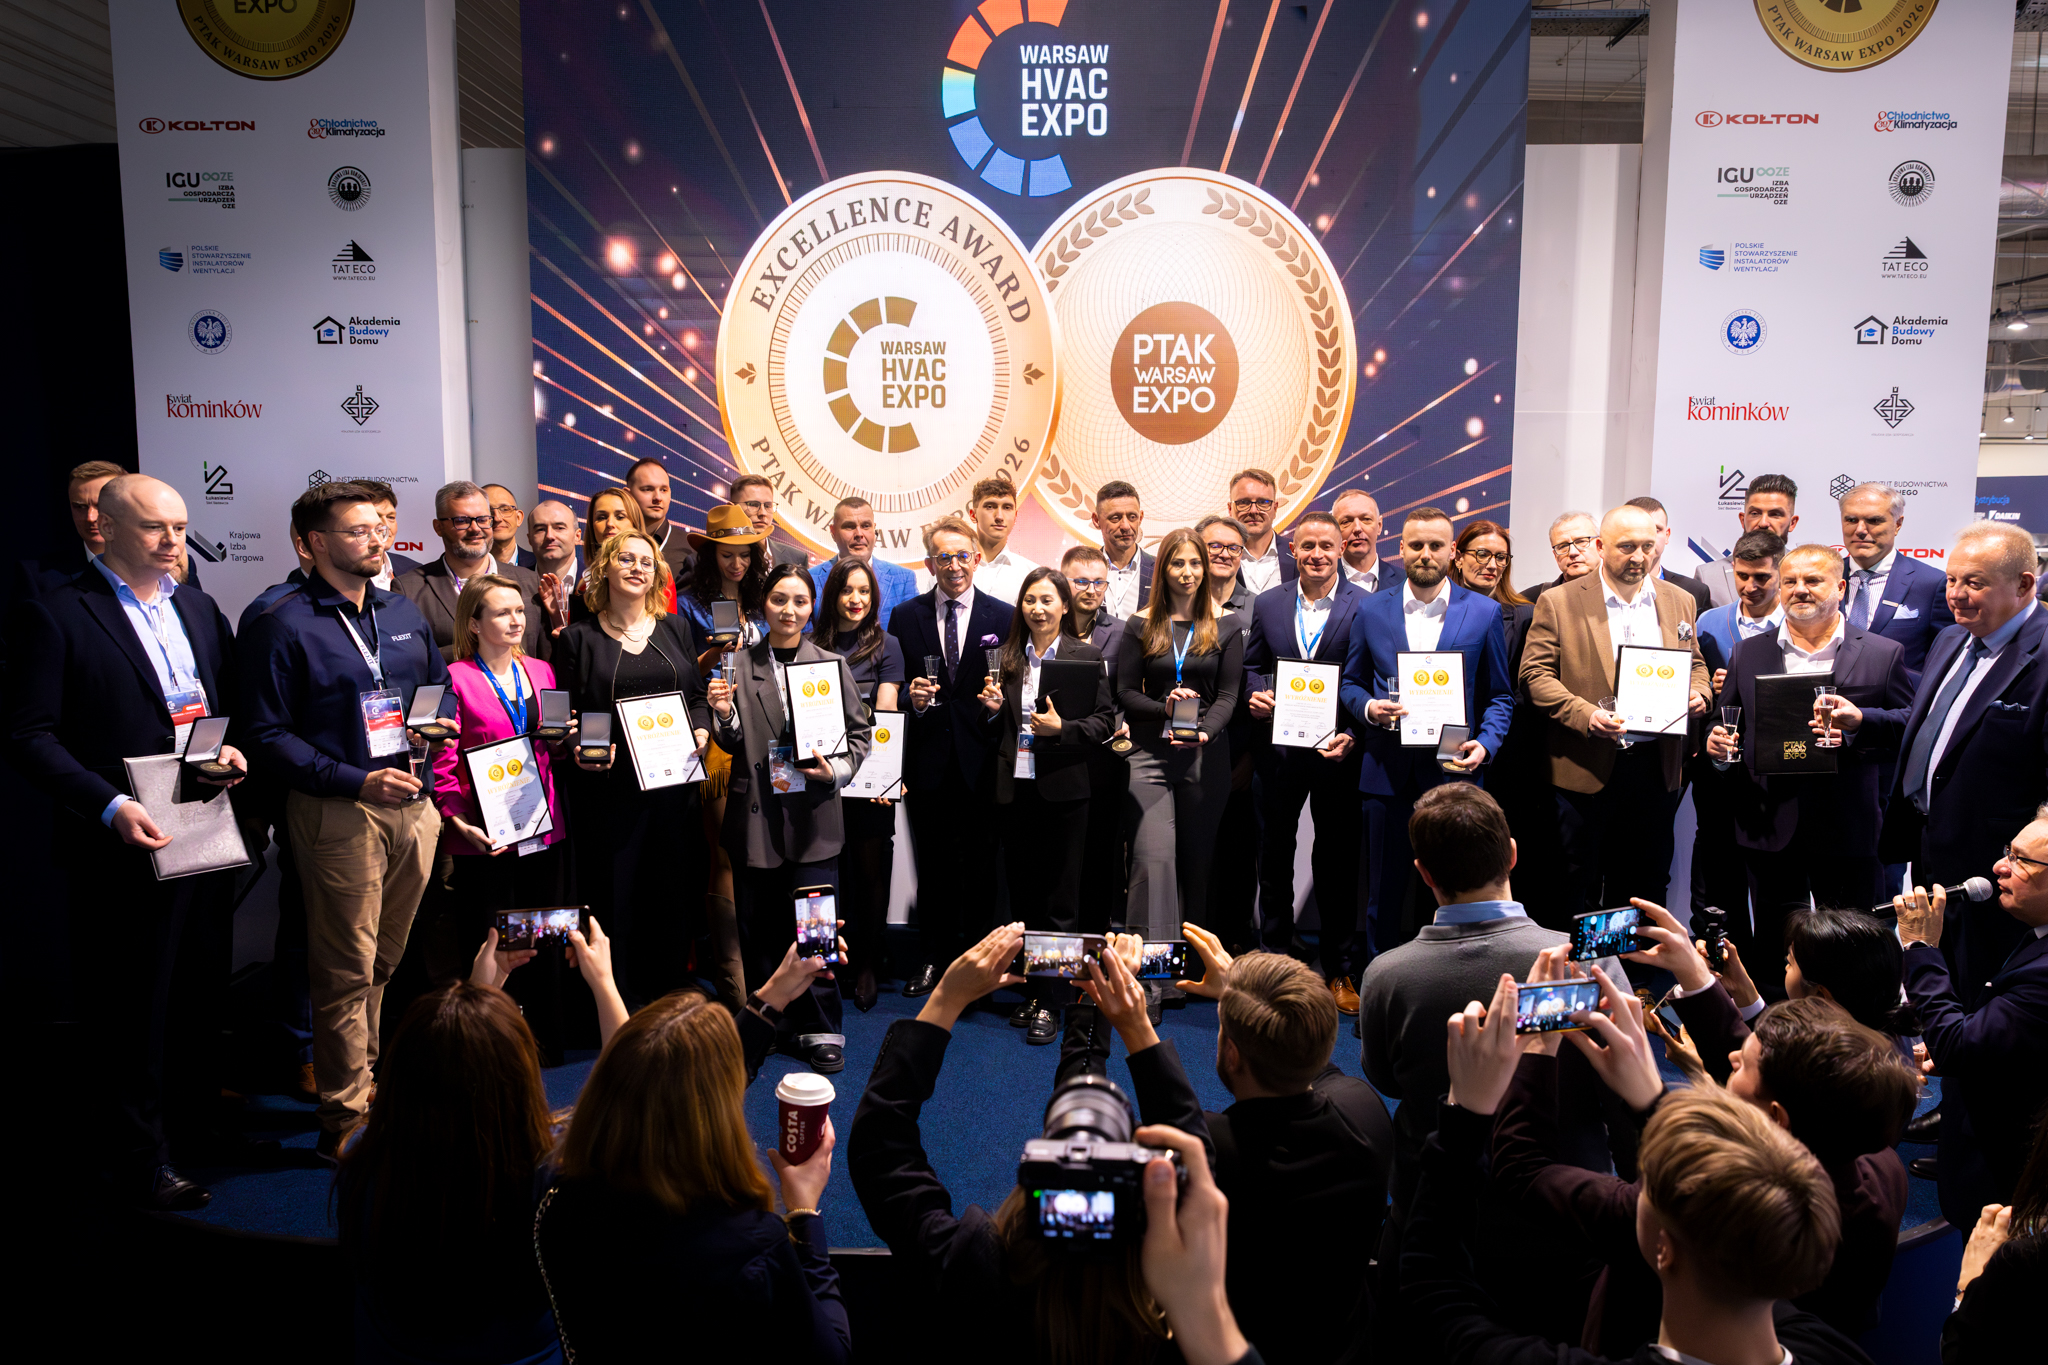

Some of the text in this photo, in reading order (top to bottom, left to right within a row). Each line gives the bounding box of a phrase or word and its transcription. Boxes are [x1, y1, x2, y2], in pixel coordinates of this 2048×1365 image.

[1768, 4, 1924, 61] PTAK WARSAW EXPO 2026
[194, 14, 340, 70] PTAK WARSAW EXPO 2026
[1020, 44, 1109, 64] WARSAW
[1022, 68, 1108, 100] HVAC
[318, 119, 377, 128] Chłodnictwo
[1022, 103, 1108, 136] EXPO
[1726, 114, 1819, 124] KOŁTON
[1887, 111, 1950, 120] Chłodnictwo
[168, 120, 255, 131] KOŁTON
[326, 127, 385, 138] Klimatyzacja
[1894, 120, 1957, 130] Klimatyzacja
[166, 172, 200, 188] IGU
[1718, 167, 1754, 183] IGU
[750, 196, 1031, 323] EXCELLENCE AWARD
[349, 316, 400, 325] Akademia
[1893, 316, 1948, 325] Akademia
[349, 326, 389, 338] Budowy
[350, 336, 378, 344] Domu
[1892, 326, 1936, 338] Budowy
[880, 341, 946, 354] WARSAW
[1892, 336, 1922, 345] Domu
[1134, 334, 1216, 364] PTAK
[882, 358, 946, 381] HVAC
[1134, 366, 1216, 384] WARSAW
[883, 384, 946, 408] EXPO
[1133, 386, 1216, 413] EXPO
[166, 394, 262, 418] kominków
[1688, 396, 1790, 421] kominków
[751, 436, 802, 506] PTAK
[805, 498, 912, 548] WAW
[229, 532, 261, 540] Krajowa
[230, 554, 264, 563] Targowa
[391, 632, 411, 641] FLEXIT
[787, 1110, 798, 1153] COSTA
